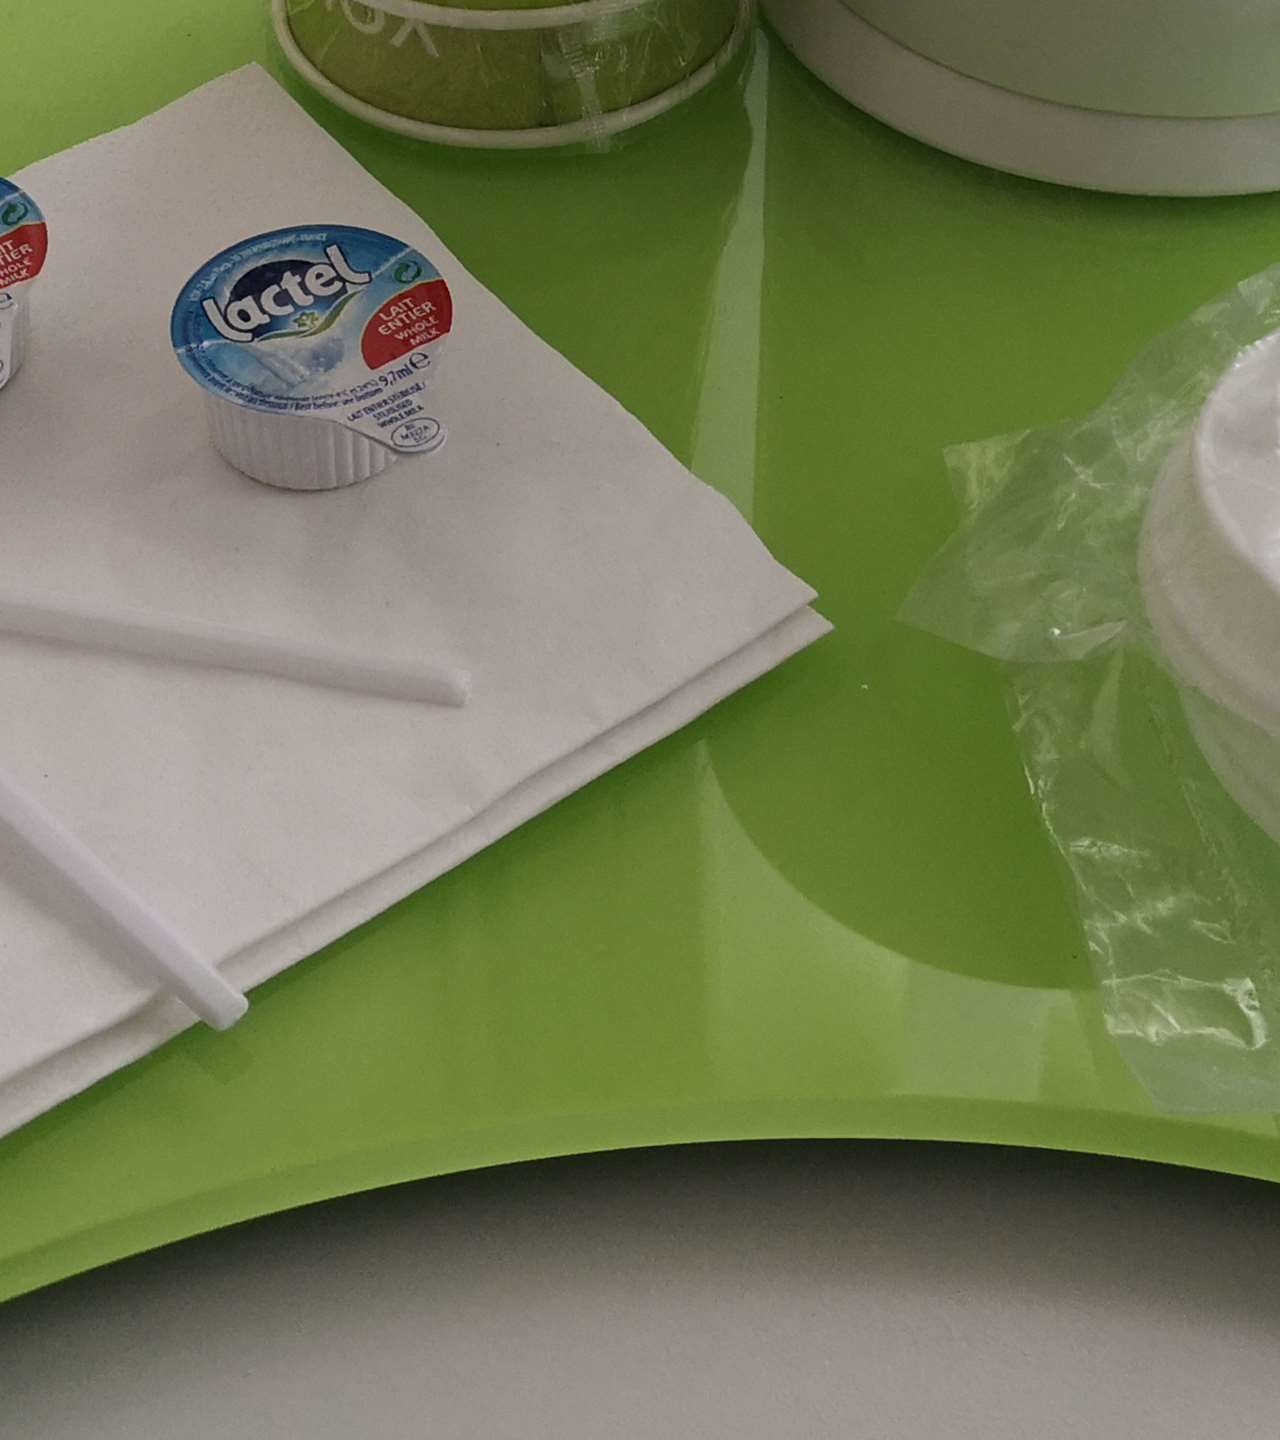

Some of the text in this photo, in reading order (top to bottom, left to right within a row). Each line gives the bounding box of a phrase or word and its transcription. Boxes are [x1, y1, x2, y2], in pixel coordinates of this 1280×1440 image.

[377, 301, 438, 337] ENTIER
[378, 297, 416, 321] LAIT
[393, 317, 439, 342] WHOLE
[410, 327, 442, 347] MILK
